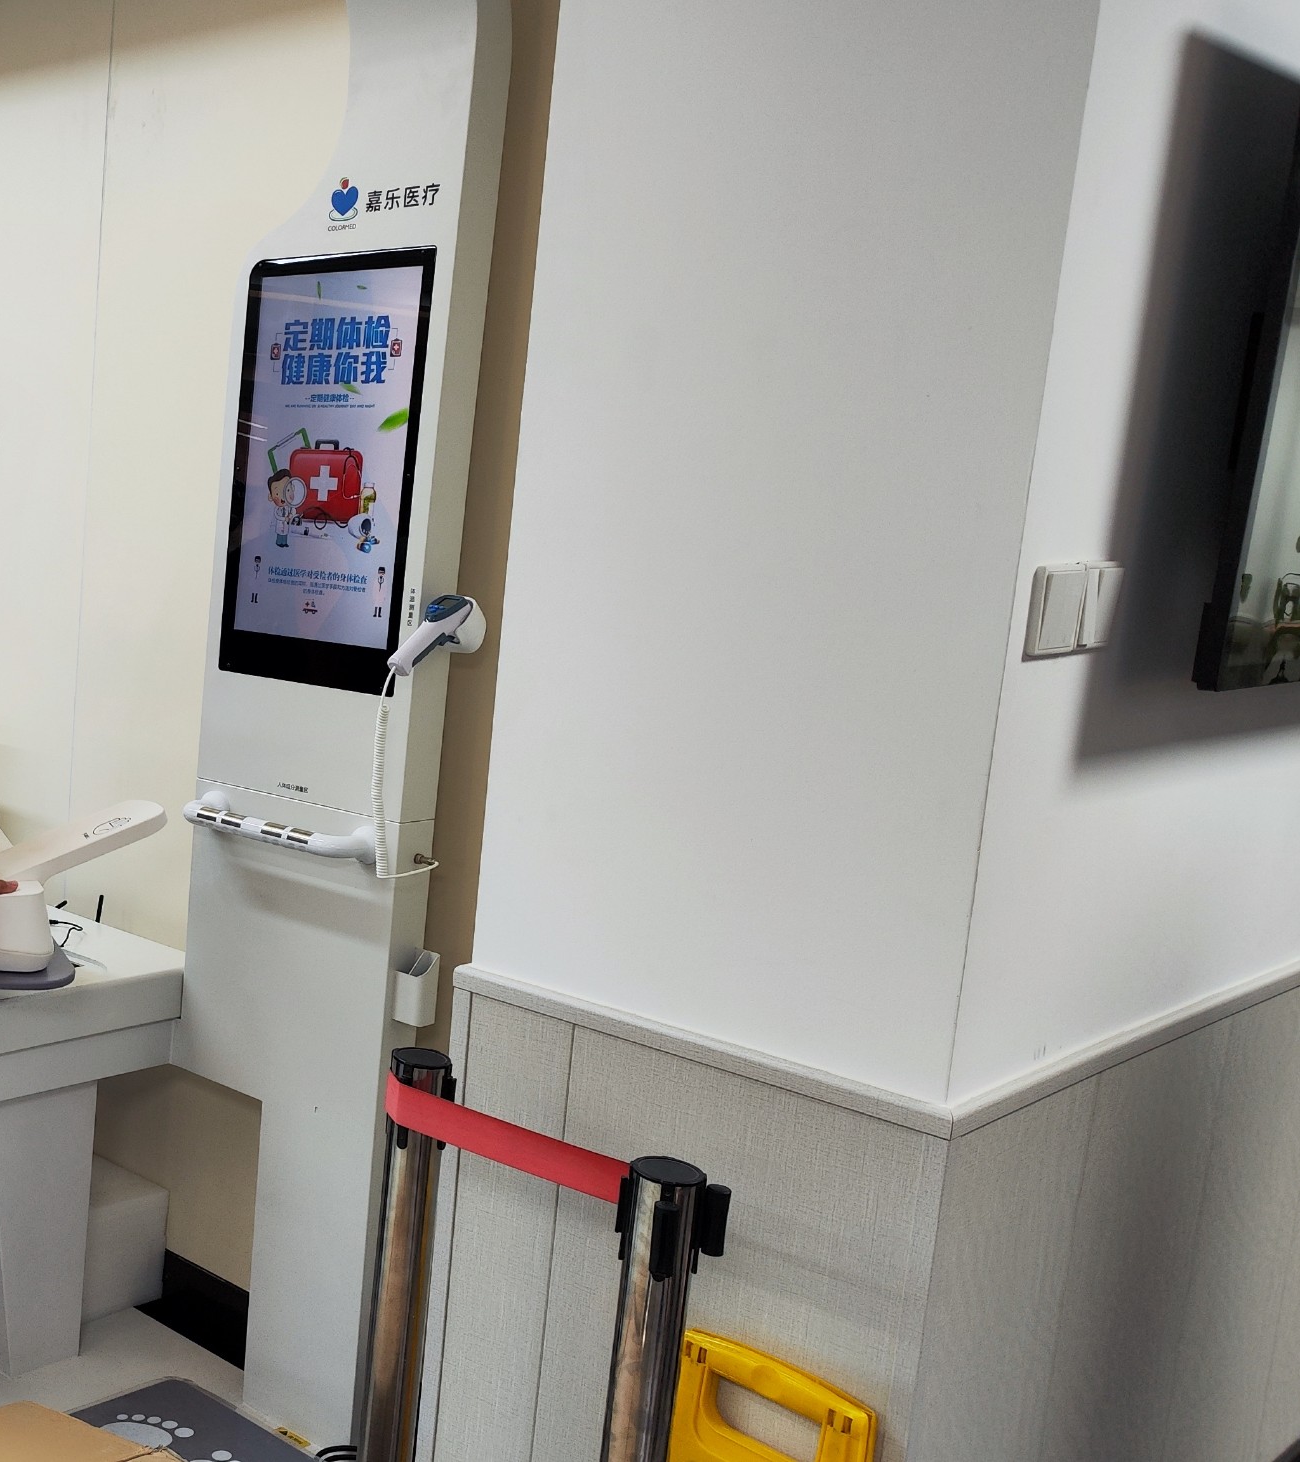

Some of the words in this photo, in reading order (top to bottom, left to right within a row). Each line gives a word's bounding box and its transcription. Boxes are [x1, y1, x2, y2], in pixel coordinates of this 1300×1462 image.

[365, 183, 440, 212] 嘉乐医疗
[283, 315, 391, 351] 定期体检
[281, 351, 387, 385] 健康你我
